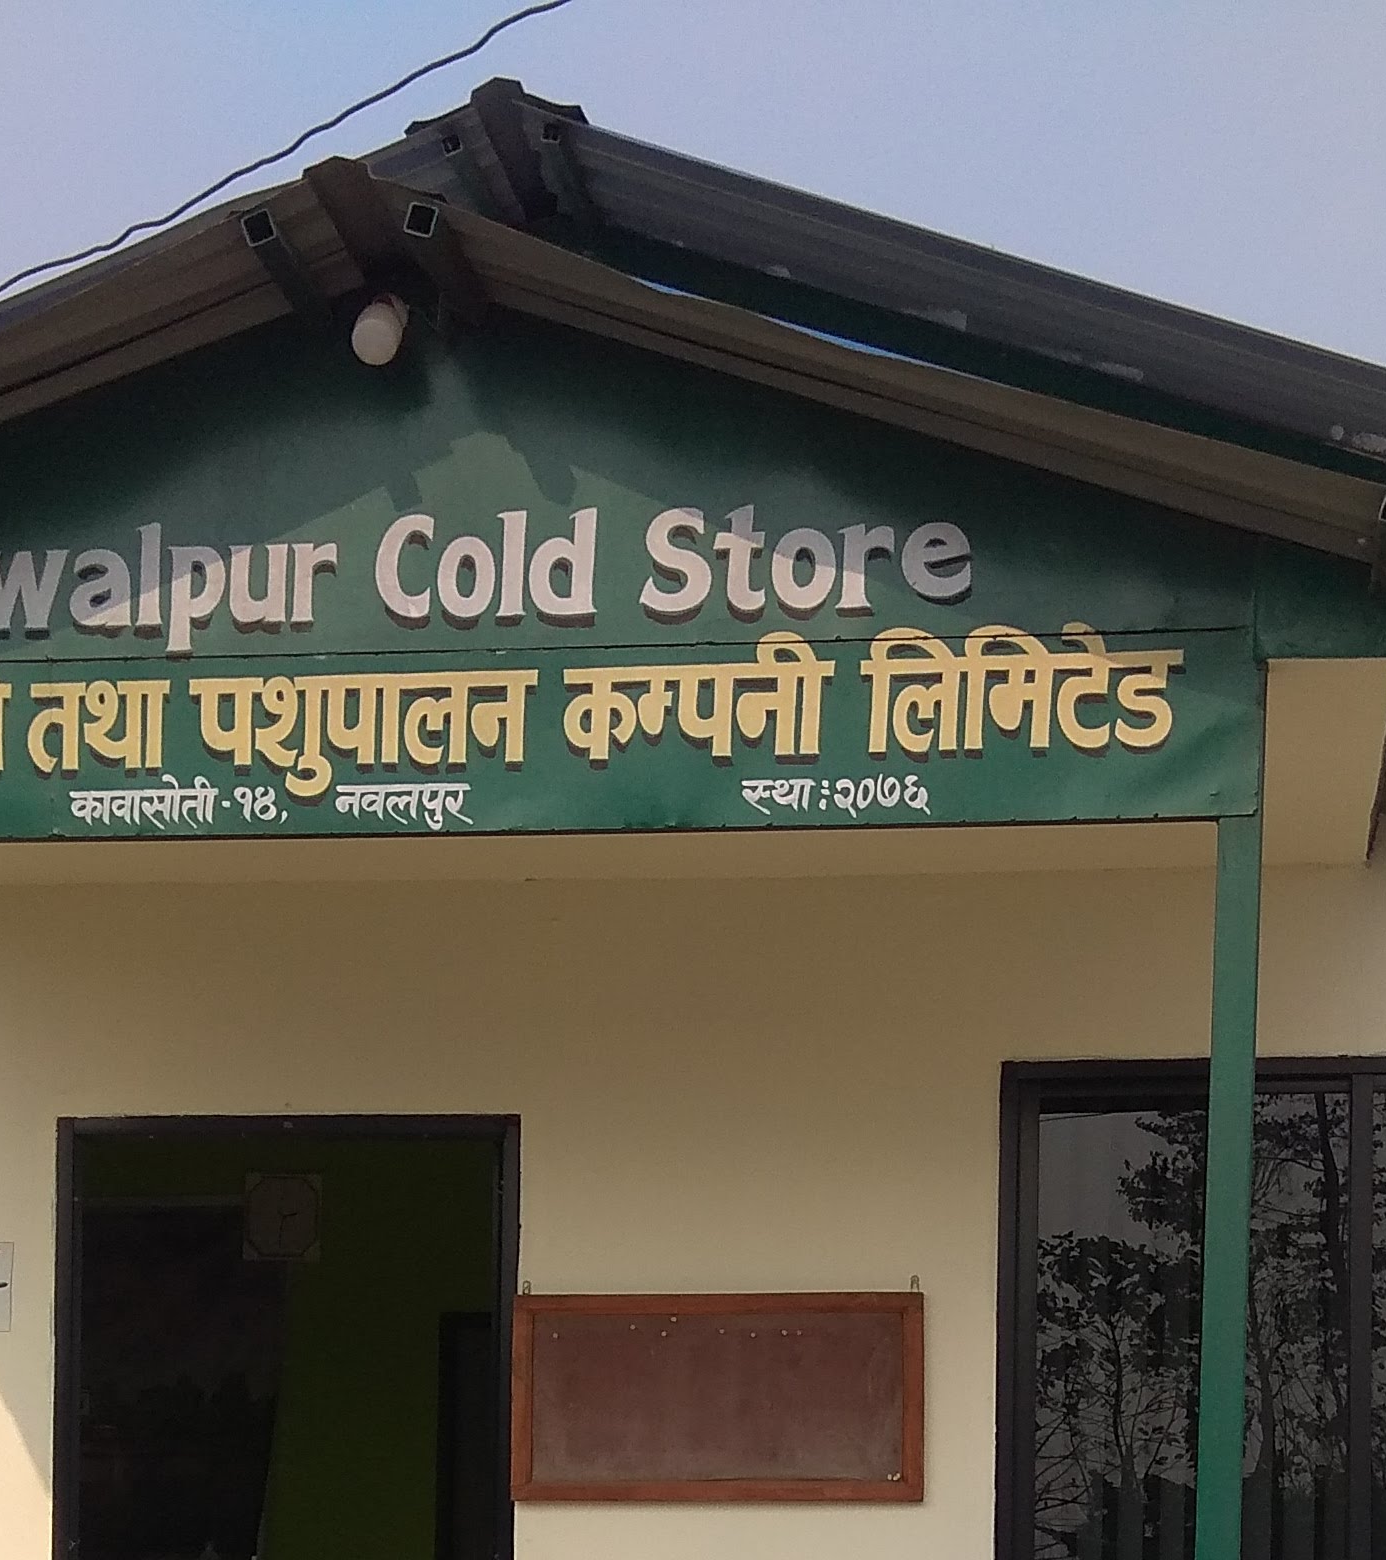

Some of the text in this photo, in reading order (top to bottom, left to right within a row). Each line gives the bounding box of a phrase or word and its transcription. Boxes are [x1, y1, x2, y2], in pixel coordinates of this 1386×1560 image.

[376, 507, 599, 619] Cold
[641, 503, 973, 617] Store
[28, 677, 171, 771] तथा
[190, 668, 538, 797] पशुपालन
[563, 631, 835, 760] कम्पनी
[862, 622, 1184, 755] लिमिटेड
[335, 782, 474, 830] नवलपुर
